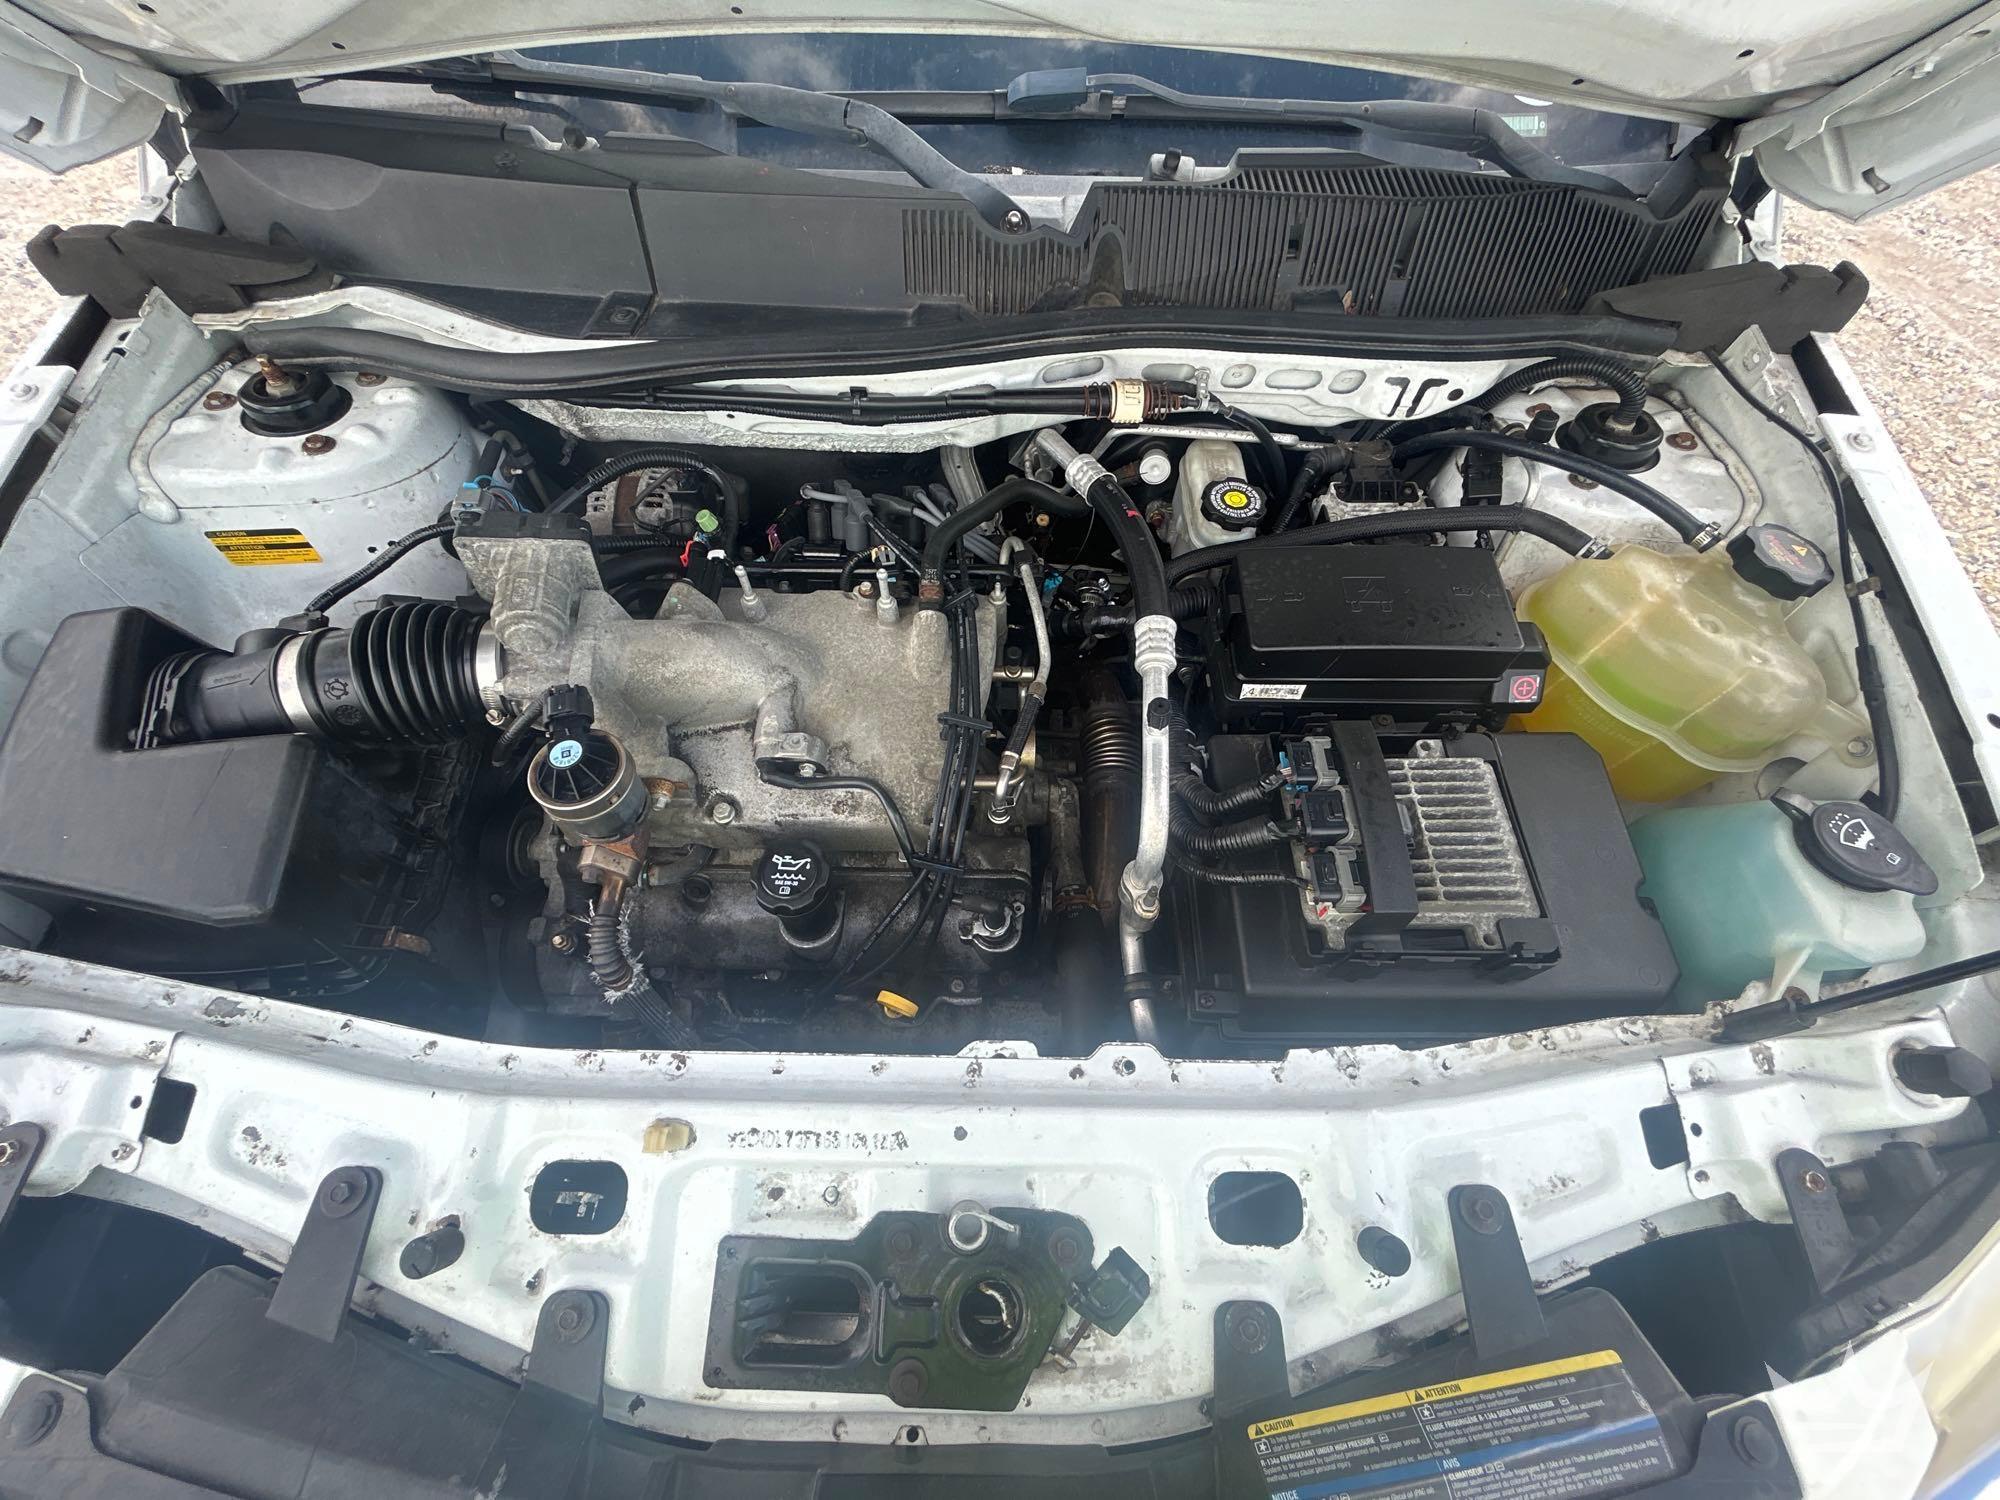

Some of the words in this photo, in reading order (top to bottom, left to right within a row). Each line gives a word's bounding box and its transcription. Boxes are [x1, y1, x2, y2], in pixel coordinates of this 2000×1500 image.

[1424, 1382, 1461, 1398] ATTENTION
[1262, 1418, 1294, 1432] CAUTION
[1441, 1457, 1460, 1469] AVIS
[1271, 1489, 1299, 1500] NOTICE
